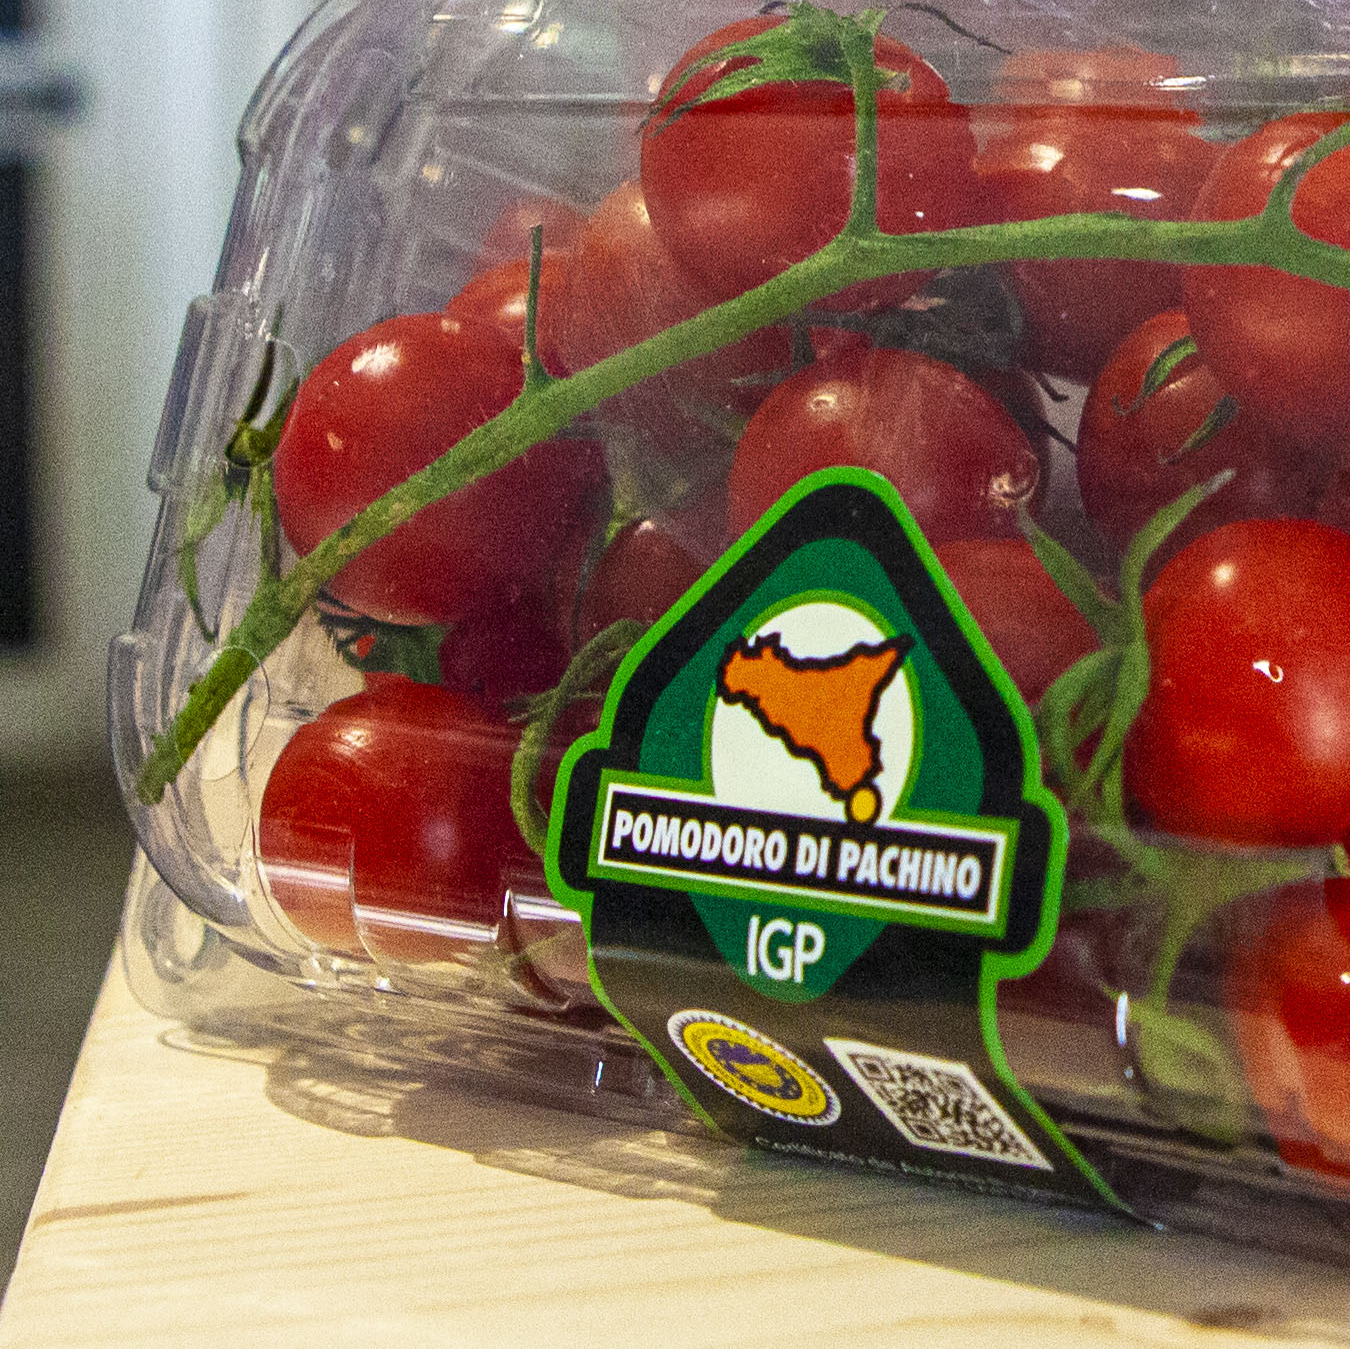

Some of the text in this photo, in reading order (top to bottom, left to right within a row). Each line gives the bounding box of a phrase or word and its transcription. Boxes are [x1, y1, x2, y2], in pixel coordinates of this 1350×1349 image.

[612, 810, 982, 899] POMODORO DI PACHINO
[746, 914, 826, 983] IGP
